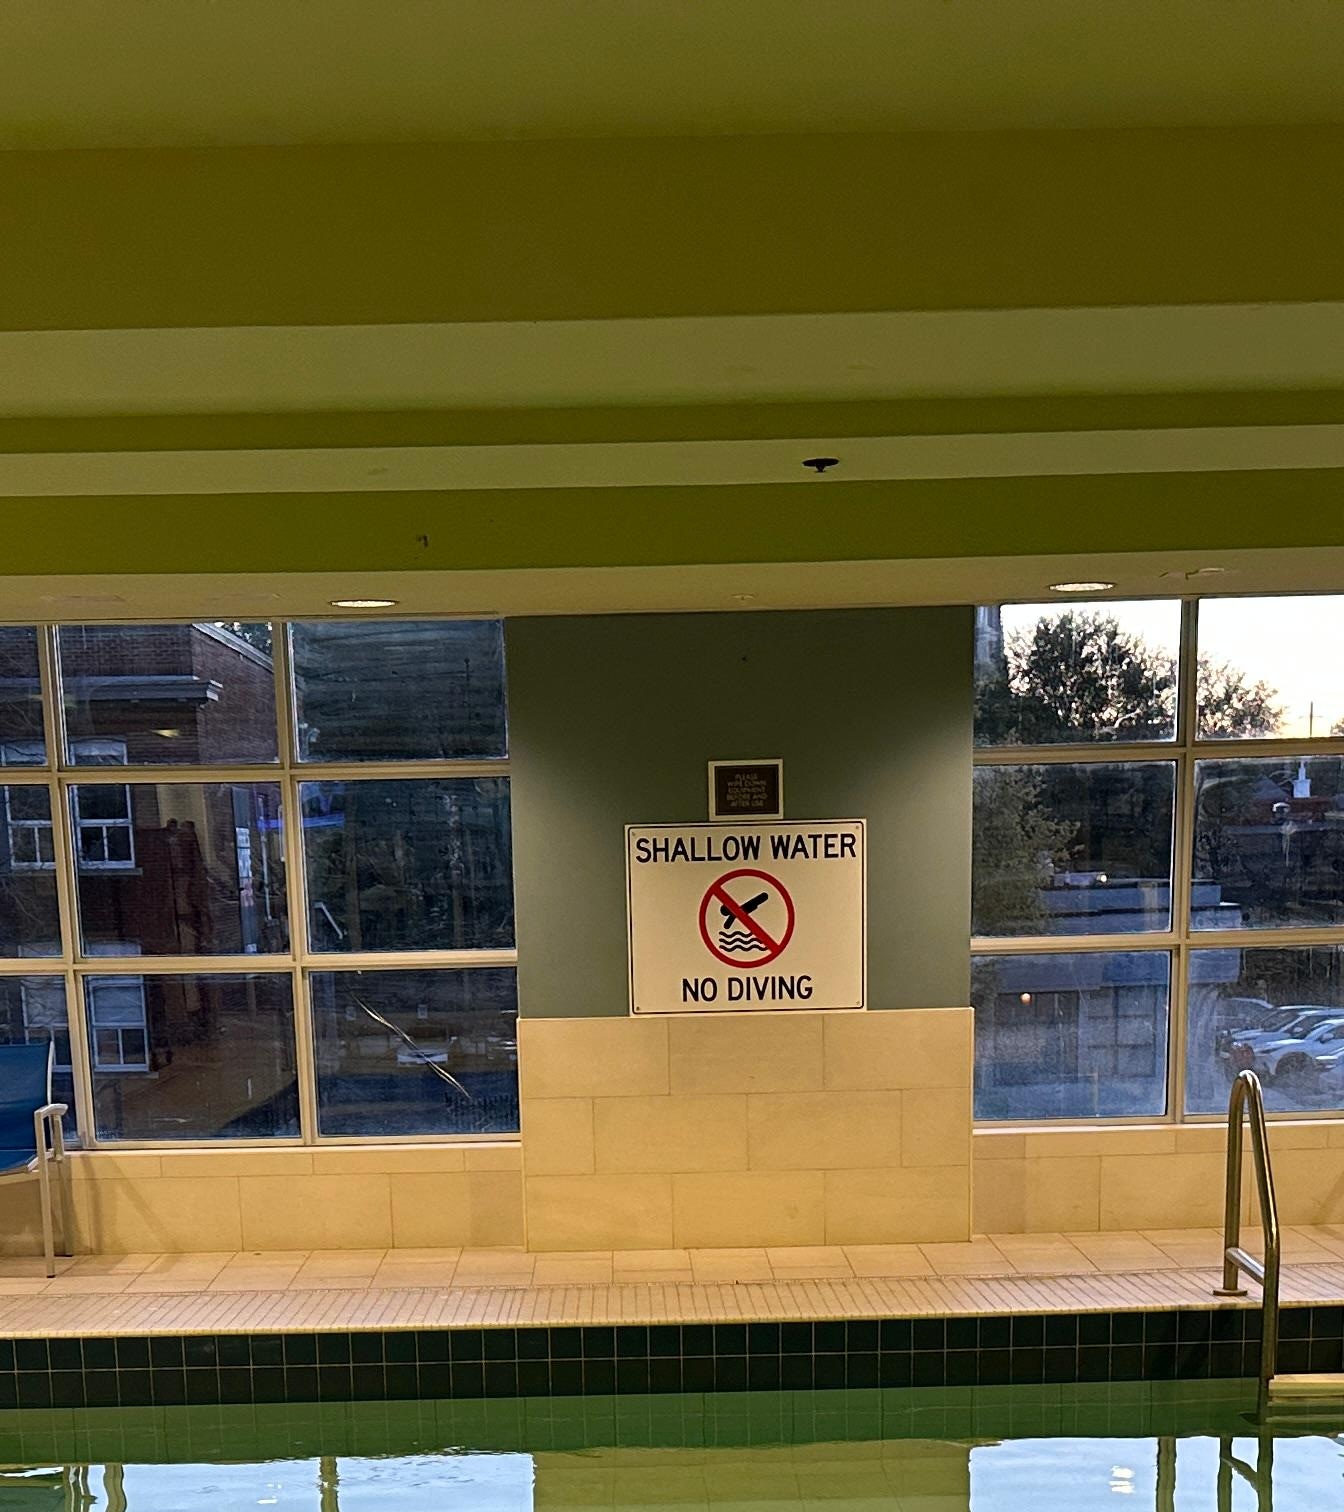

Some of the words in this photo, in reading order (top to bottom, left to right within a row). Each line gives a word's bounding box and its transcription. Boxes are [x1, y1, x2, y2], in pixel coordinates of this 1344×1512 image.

[635, 835, 761, 863] SHALLOW
[770, 833, 857, 860] WATER
[682, 978, 718, 1002] NO
[728, 975, 813, 1001] DIVING
